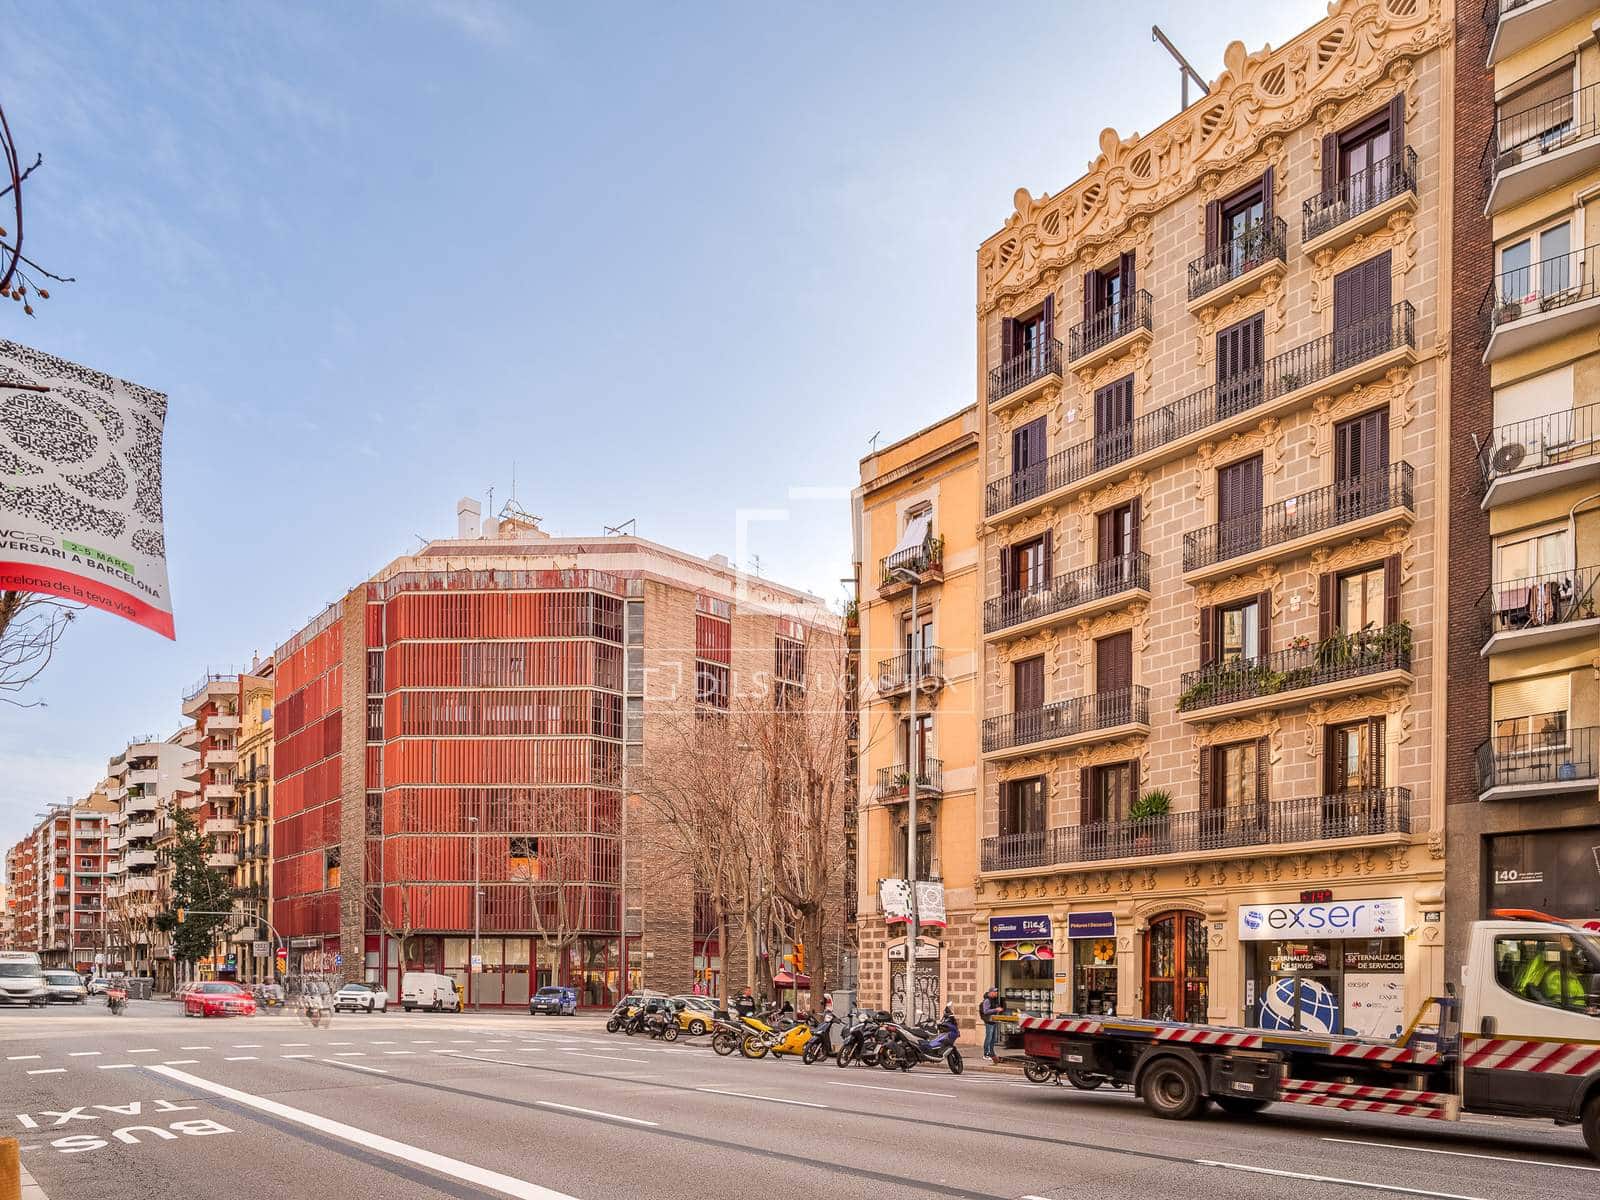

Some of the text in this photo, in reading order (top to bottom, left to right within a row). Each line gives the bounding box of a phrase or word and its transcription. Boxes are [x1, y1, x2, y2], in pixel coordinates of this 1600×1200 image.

[96, 552, 129, 572] MARÇ
[71, 554, 82, 564] A
[86, 558, 161, 599] BARCELONA
[54, 580, 71, 593] de
[73, 585, 84, 597] la
[86, 590, 113, 606] teva
[113, 600, 136, 617] vida
[1268, 904, 1365, 929] exser
[1369, 961, 1404, 969] SERVICIOS
[16, 1100, 198, 1128] TAXI
[51, 1119, 235, 1153] BUS
